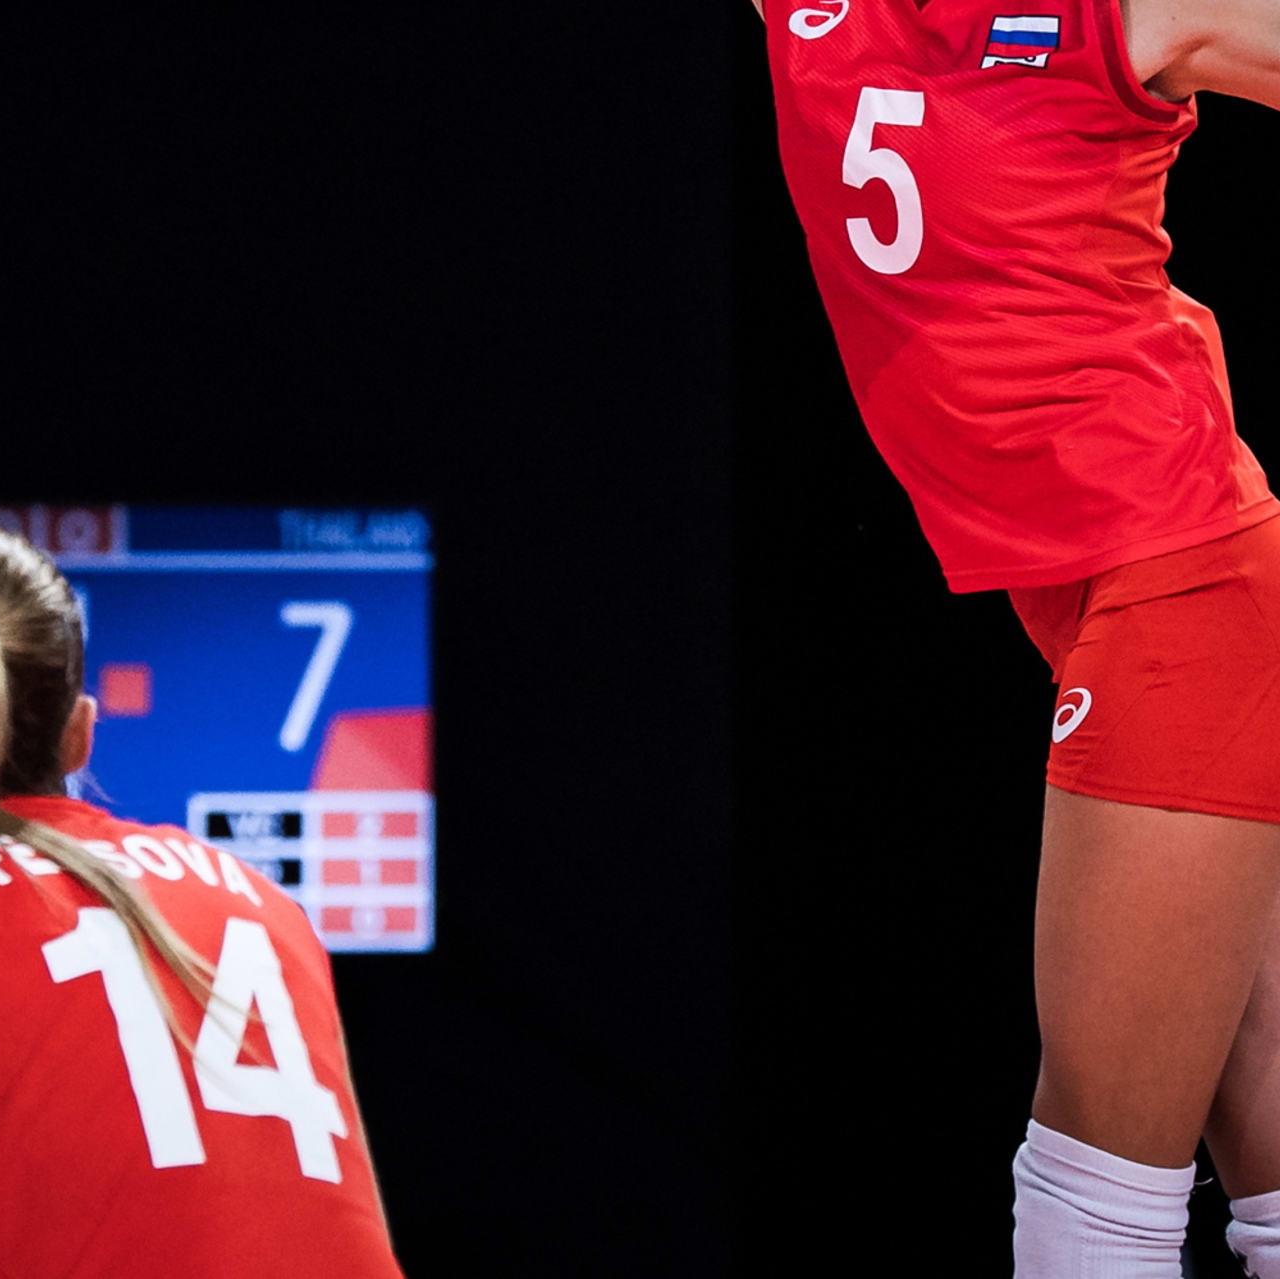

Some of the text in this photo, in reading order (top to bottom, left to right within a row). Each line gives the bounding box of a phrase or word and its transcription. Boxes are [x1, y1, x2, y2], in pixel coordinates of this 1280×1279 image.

[841, 86, 925, 275] 5
[278, 600, 356, 754] 7
[40, 906, 349, 1185] 14
